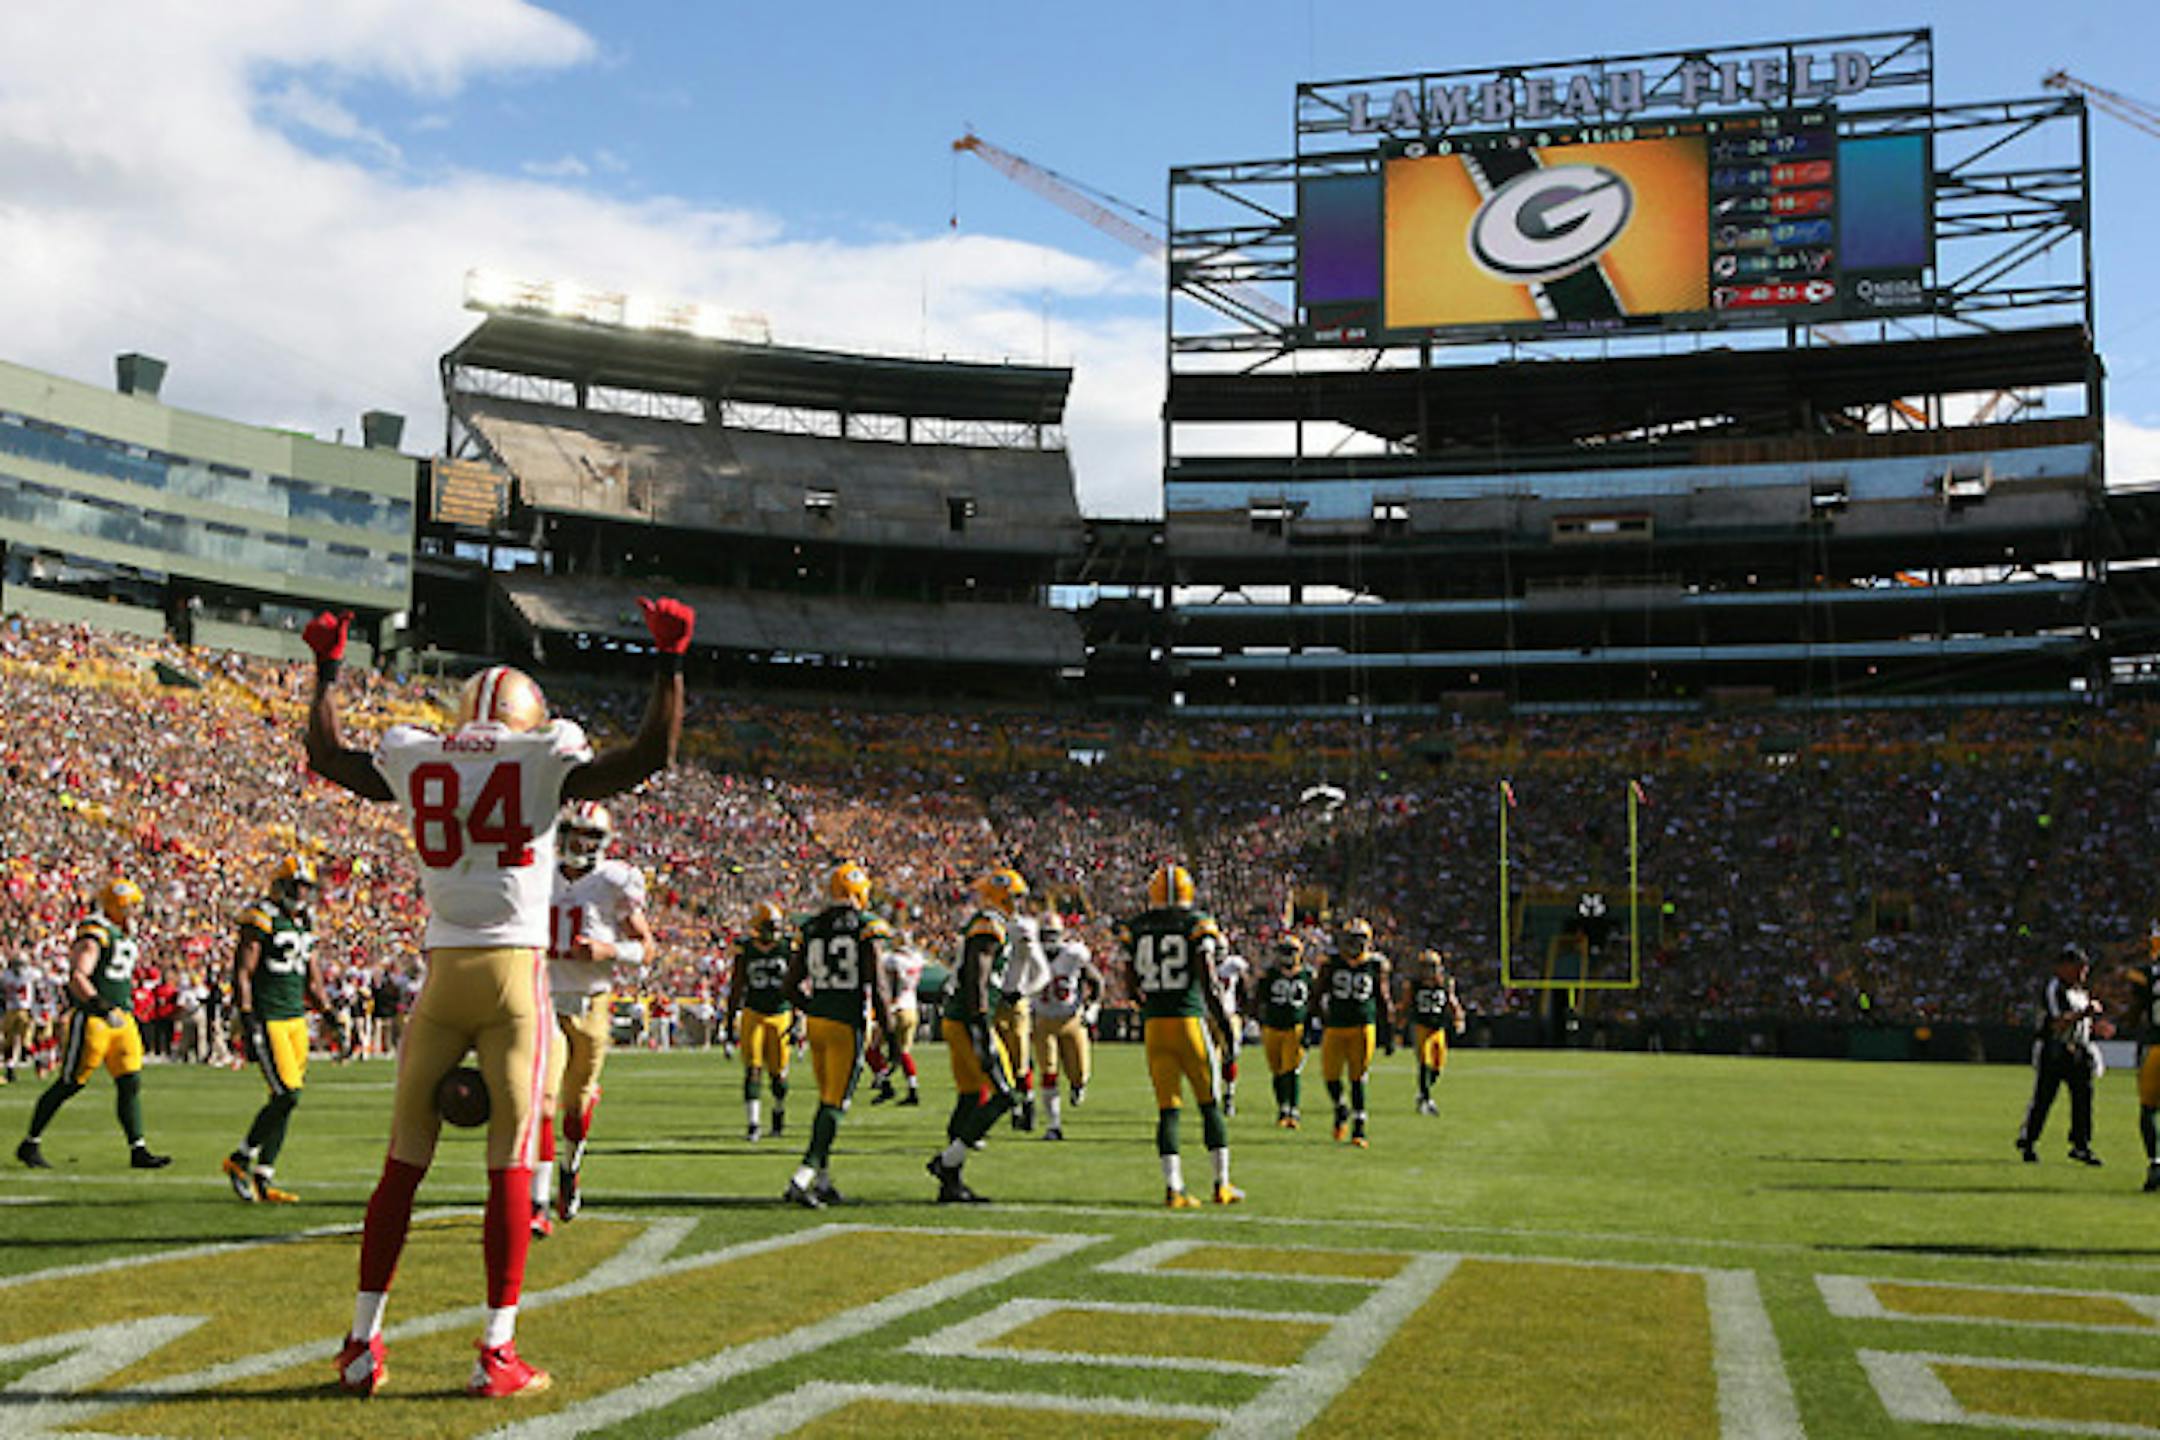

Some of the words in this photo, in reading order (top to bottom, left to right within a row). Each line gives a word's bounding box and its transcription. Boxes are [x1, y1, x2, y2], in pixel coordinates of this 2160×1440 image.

[1348, 68, 1647, 134] LAMBEAU
[1681, 52, 1873, 108] FIELD
[409, 761, 535, 869] 84
[546, 906, 583, 960] 11
[807, 935, 859, 989] 43
[1135, 934, 1189, 991] 42
[1331, 969, 1374, 1001] 99
[1270, 978, 1309, 1006] 90
